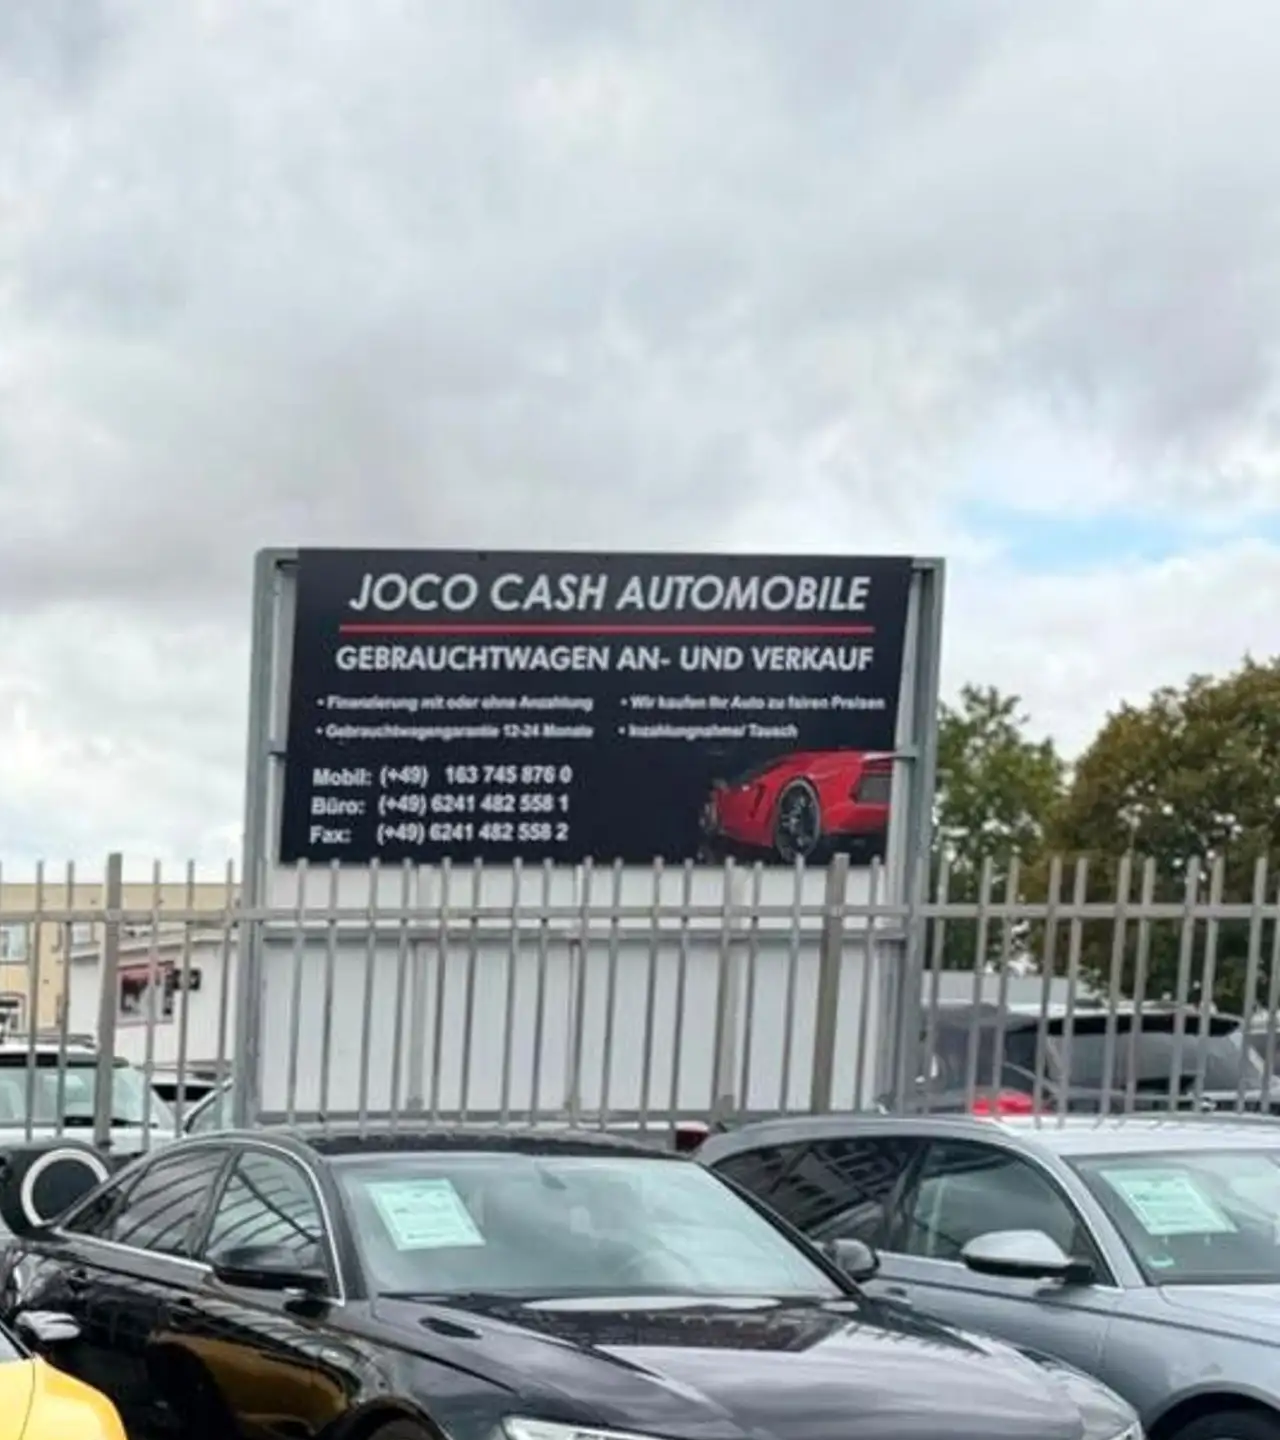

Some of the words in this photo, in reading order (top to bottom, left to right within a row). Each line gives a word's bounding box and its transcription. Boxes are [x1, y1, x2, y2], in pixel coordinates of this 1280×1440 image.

[348, 572, 478, 612] JOCO
[490, 572, 608, 612] CASH
[615, 573, 871, 612] AUTOMOBILE
[336, 644, 610, 672] GEBRAUCHTWAGEN
[616, 645, 670, 671] AN-
[680, 645, 744, 672] UND
[751, 645, 873, 672] VERKAUF
[445, 695, 480, 710] oder
[481, 695, 517, 710] ohne
[630, 695, 656, 710] Wir
[657, 694, 707, 710] kaufen
[730, 695, 766, 710] Auto
[747, 723, 798, 739] Tausch
[312, 766, 372, 786] Mobil:
[379, 764, 429, 788] (+49)
[483, 764, 518, 784] 745
[521, 764, 556, 784] 876
[558, 764, 573, 784] 0
[311, 795, 365, 815] Büro:
[378, 793, 427, 817] (+49)
[430, 793, 475, 813] 6241
[479, 793, 516, 813] 482
[558, 793, 569, 813] 1
[309, 824, 350, 844] Fax:
[376, 821, 426, 846] (+49)
[429, 821, 474, 842] 6241
[478, 821, 514, 842] 482
[555, 821, 570, 842] 2
